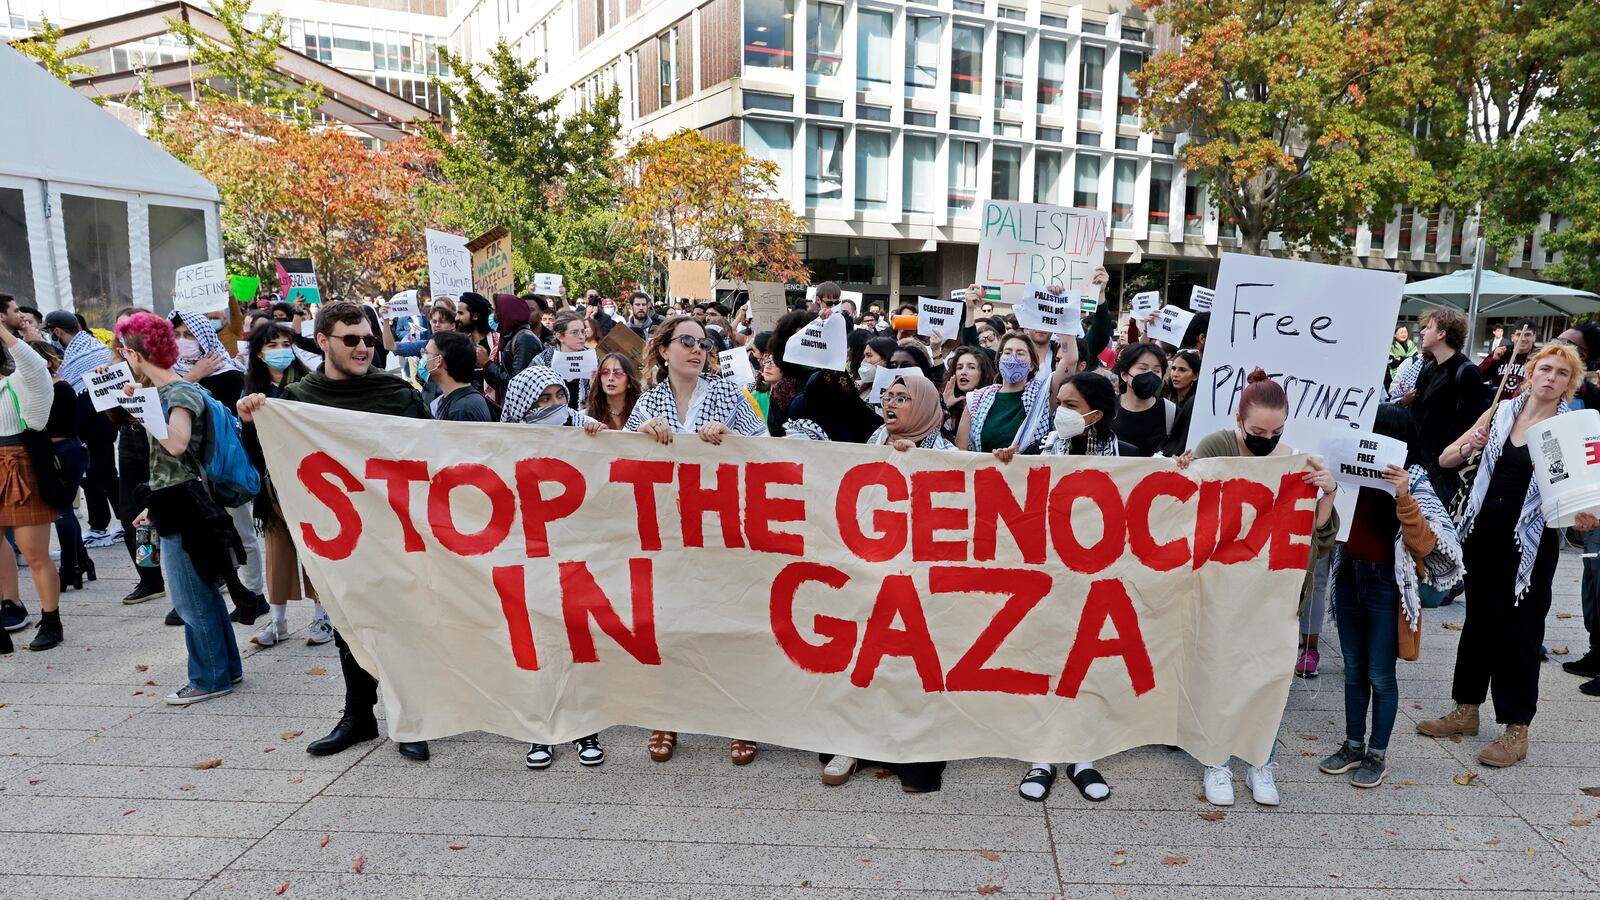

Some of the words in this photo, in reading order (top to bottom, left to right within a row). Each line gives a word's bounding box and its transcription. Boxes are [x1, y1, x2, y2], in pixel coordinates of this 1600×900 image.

[985, 203, 1107, 256] PALESTINA
[430, 239, 465, 263] PROTECT
[486, 240, 503, 259] FOR
[440, 257, 462, 272] OUR
[477, 252, 508, 278] WADEA
[177, 264, 216, 286] FREE
[474, 267, 508, 292] JUSTICE
[176, 279, 229, 301] ALESTIN
[1034, 290, 1069, 304] PALESTINE
[923, 303, 955, 316] CEASEFIRE
[1037, 303, 1054, 314] WILL
[1055, 306, 1064, 315] BE
[1231, 283, 1338, 348] Free
[929, 316, 945, 326] NOW
[1041, 315, 1058, 325] FREE
[800, 338, 827, 350] SANCTION
[91, 371, 117, 386] SILENCE
[116, 369, 124, 378] IS
[1212, 364, 1376, 430] PATINE!
[1359, 439, 1379, 451] FREE
[1357, 453, 1376, 464] FREE
[1340, 463, 1385, 480] PALESTIN
[297, 451, 587, 561] STOP
[608, 457, 806, 556] THE
[834, 461, 1319, 574] GENOCIDE
[492, 557, 661, 671] IN
[769, 561, 1156, 698] GAZA
